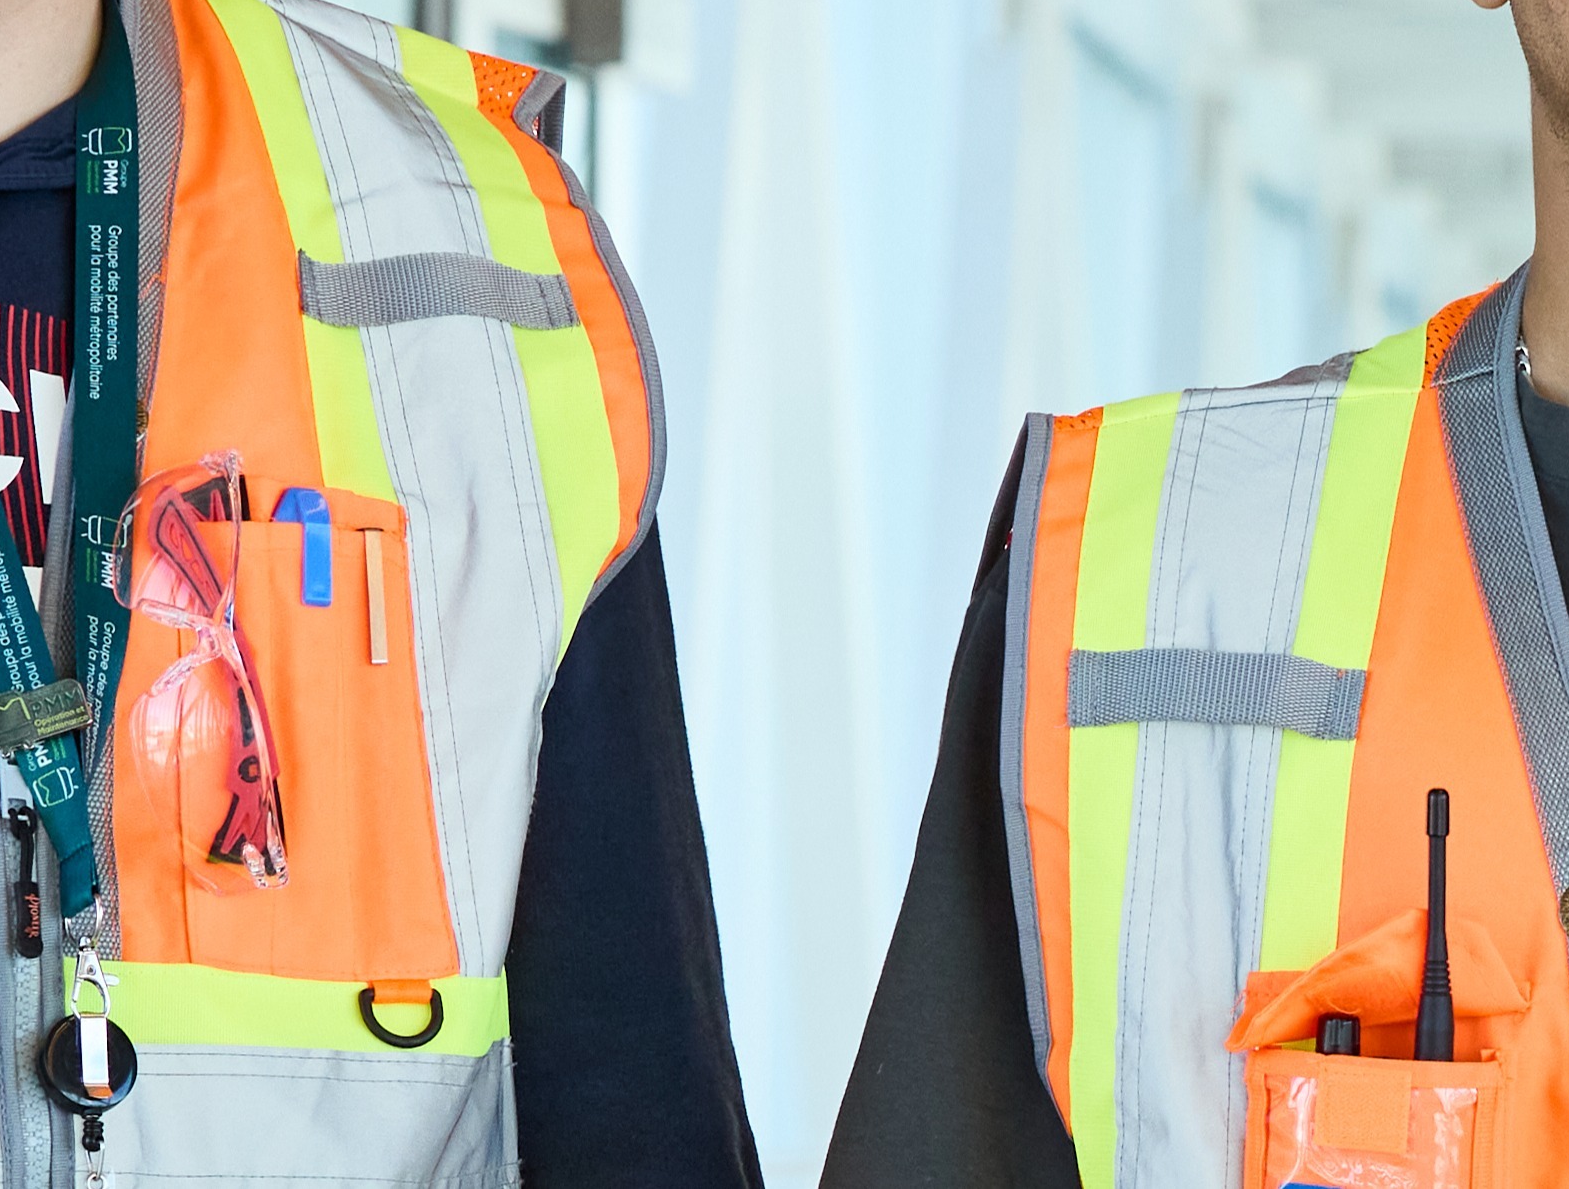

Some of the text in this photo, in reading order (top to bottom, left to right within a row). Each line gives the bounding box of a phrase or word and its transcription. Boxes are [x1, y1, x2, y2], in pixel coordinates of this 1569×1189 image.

[103, 160, 118, 194] PMM
[105, 225, 122, 361] Groupe des partenaires
[87, 225, 104, 400] pour la mobilité métropolitaine
[101, 551, 115, 589] PMM
[5, 595, 28, 642] mobilité
[86, 614, 98, 646] pour
[20, 646, 32, 660] la
[88, 647, 99, 661] la
[100, 621, 115, 670] Groupe
[3, 648, 25, 693] Groupe
[24, 660, 45, 690] pour
[97, 672, 107, 698] des
[34, 741, 52, 768] PM
